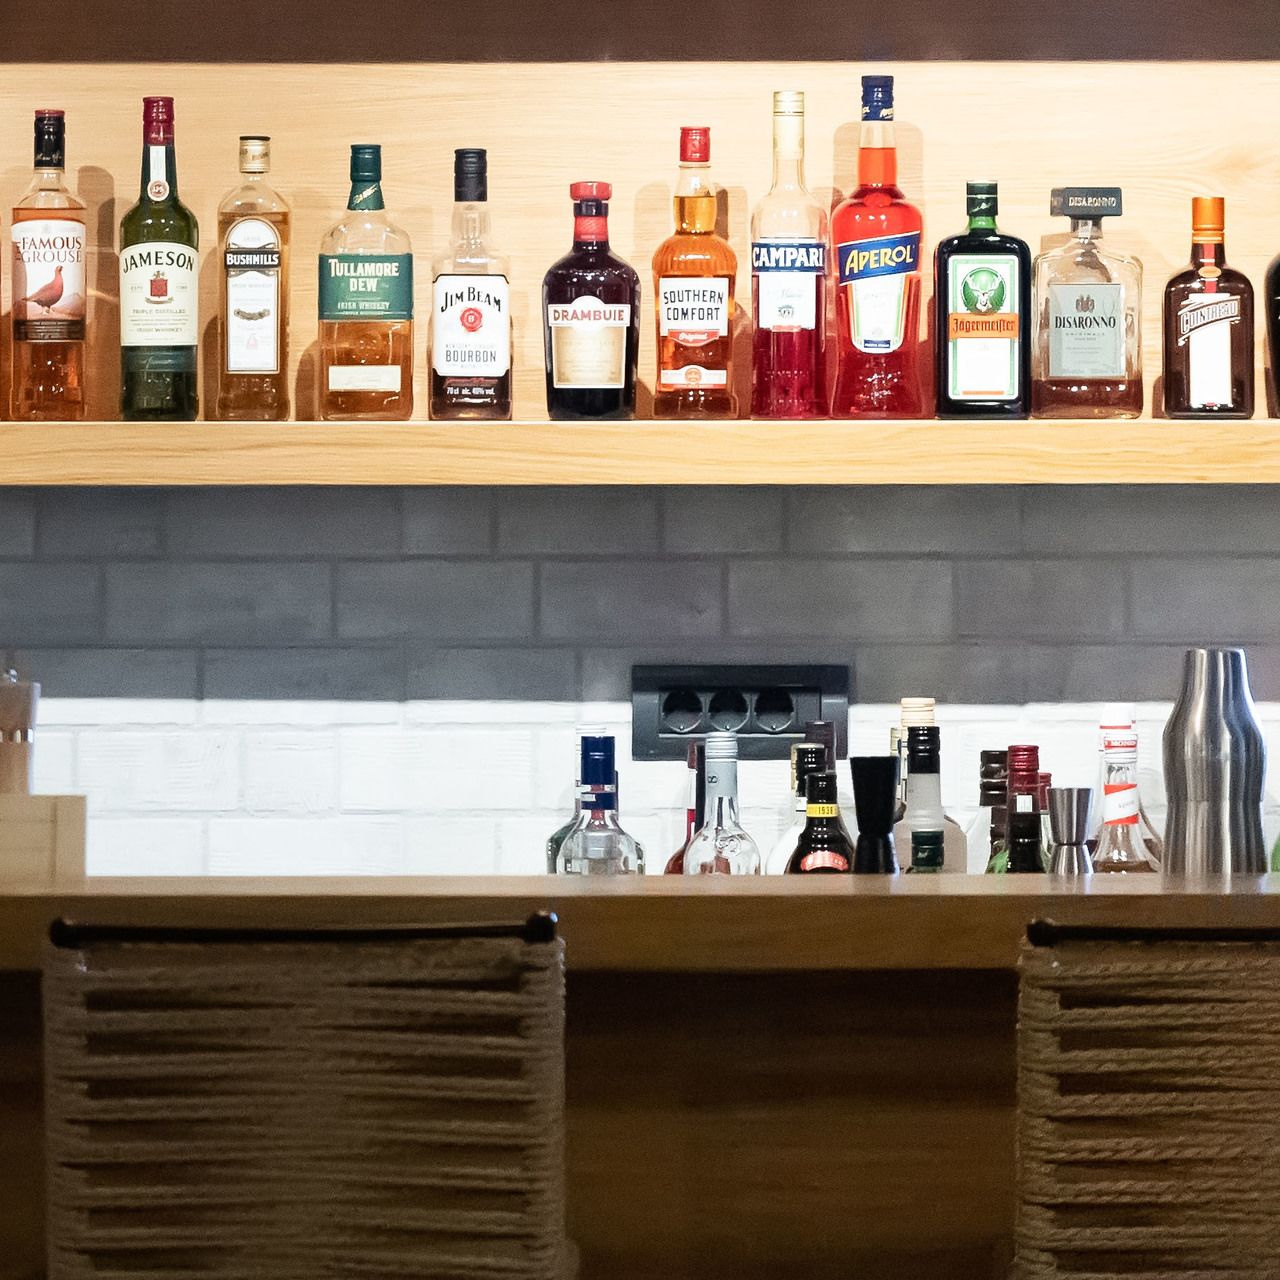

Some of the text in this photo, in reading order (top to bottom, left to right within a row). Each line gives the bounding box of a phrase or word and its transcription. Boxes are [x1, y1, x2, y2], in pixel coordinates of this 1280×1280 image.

[1068, 197, 1117, 207] DISARONNO
[22, 236, 82, 250] FAMOUS
[22, 250, 82, 263] GROUSE
[123, 251, 194, 273] JAMESON
[226, 253, 279, 265] BUSHMILLS
[752, 247, 823, 267] CAMPARI
[844, 246, 913, 276] APEROL
[328, 258, 400, 277] TULLAMORE
[349, 278, 378, 292] DEW
[440, 286, 501, 313] JIM BEAM
[663, 289, 723, 305] SOUTHERN
[553, 309, 625, 321] DRAMBUIE
[666, 307, 720, 320] COMFORT
[1180, 300, 1238, 334] COINTREAU
[1055, 316, 1116, 330] DISARONNO
[445, 349, 497, 363] BOURBON
